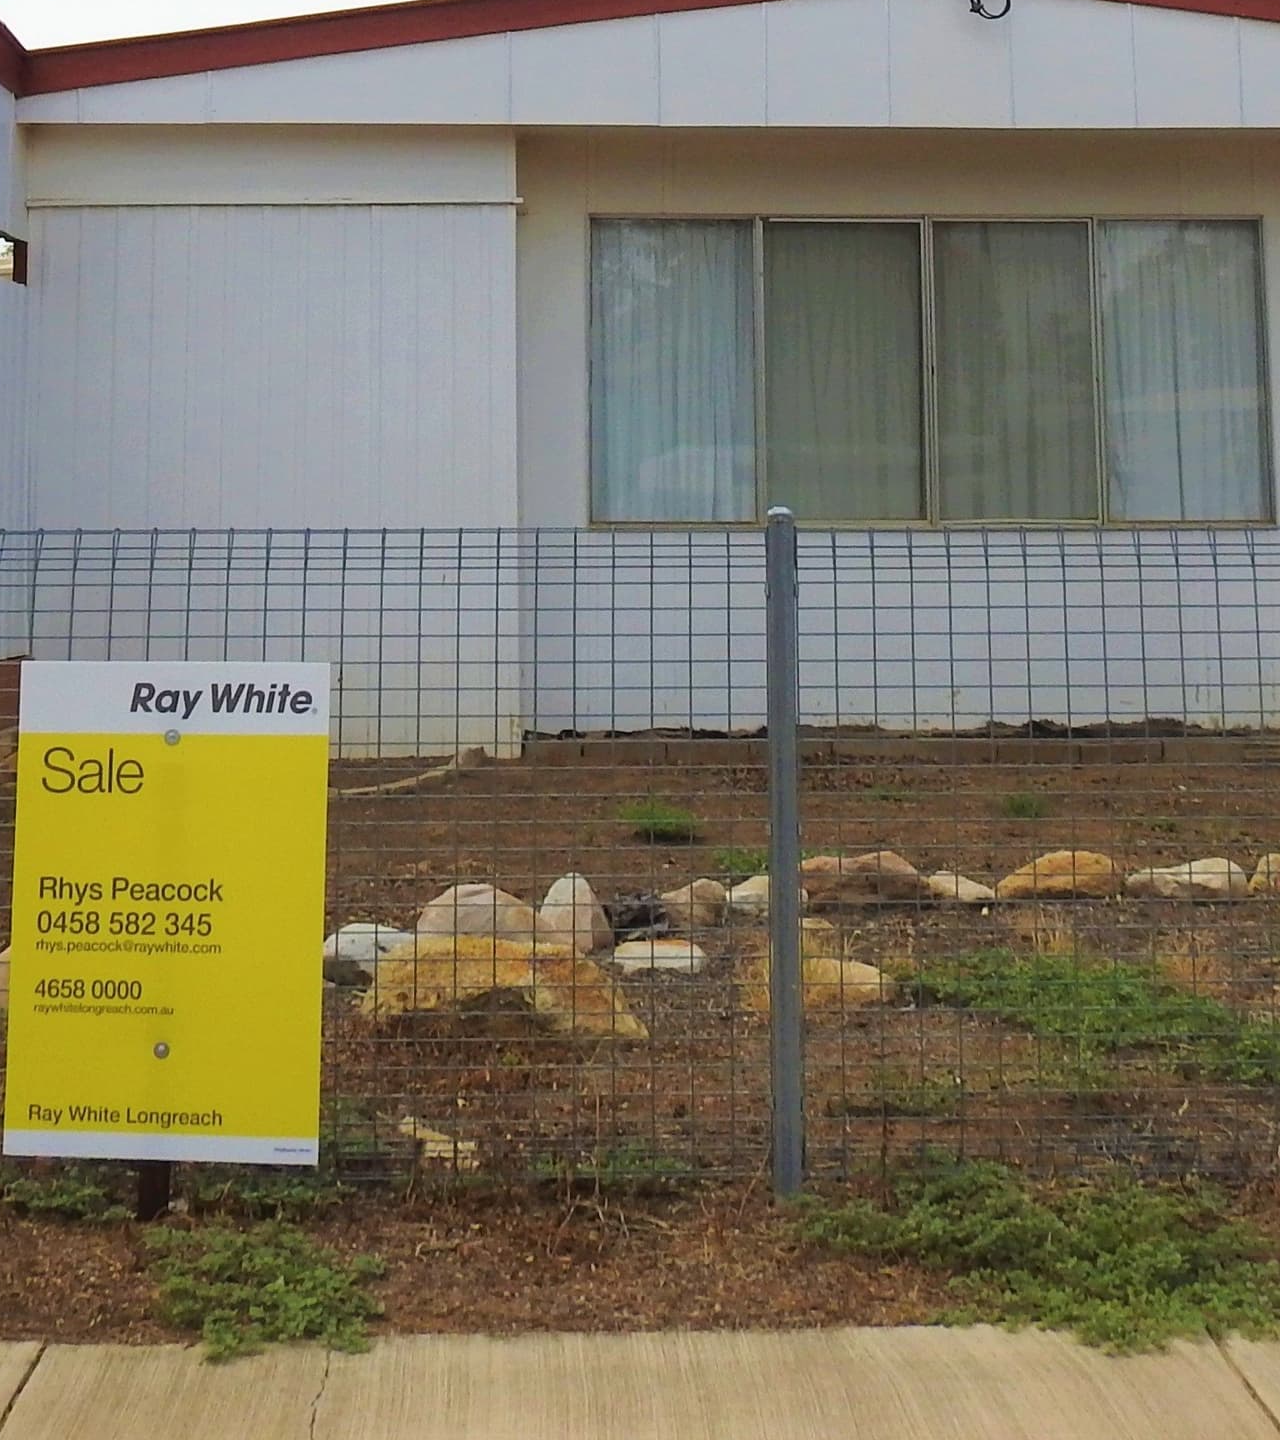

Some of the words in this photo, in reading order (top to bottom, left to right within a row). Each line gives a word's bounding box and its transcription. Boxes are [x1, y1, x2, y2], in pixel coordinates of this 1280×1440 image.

[130, 682, 202, 719] Ray
[211, 683, 313, 714] White
[41, 746, 145, 794] Sale
[38, 876, 103, 906] Rhys
[111, 877, 224, 903] Peacock
[36, 910, 101, 936] 0458
[108, 911, 157, 937] 582
[164, 912, 213, 937] 345
[35, 938, 223, 956] rhys.peacock@raywhite.com
[34, 979, 86, 1000] 4658
[91, 980, 143, 1001] 0000
[27, 1104, 63, 1126] Ray
[68, 1105, 121, 1125] White
[125, 1106, 223, 1129] Longreach
